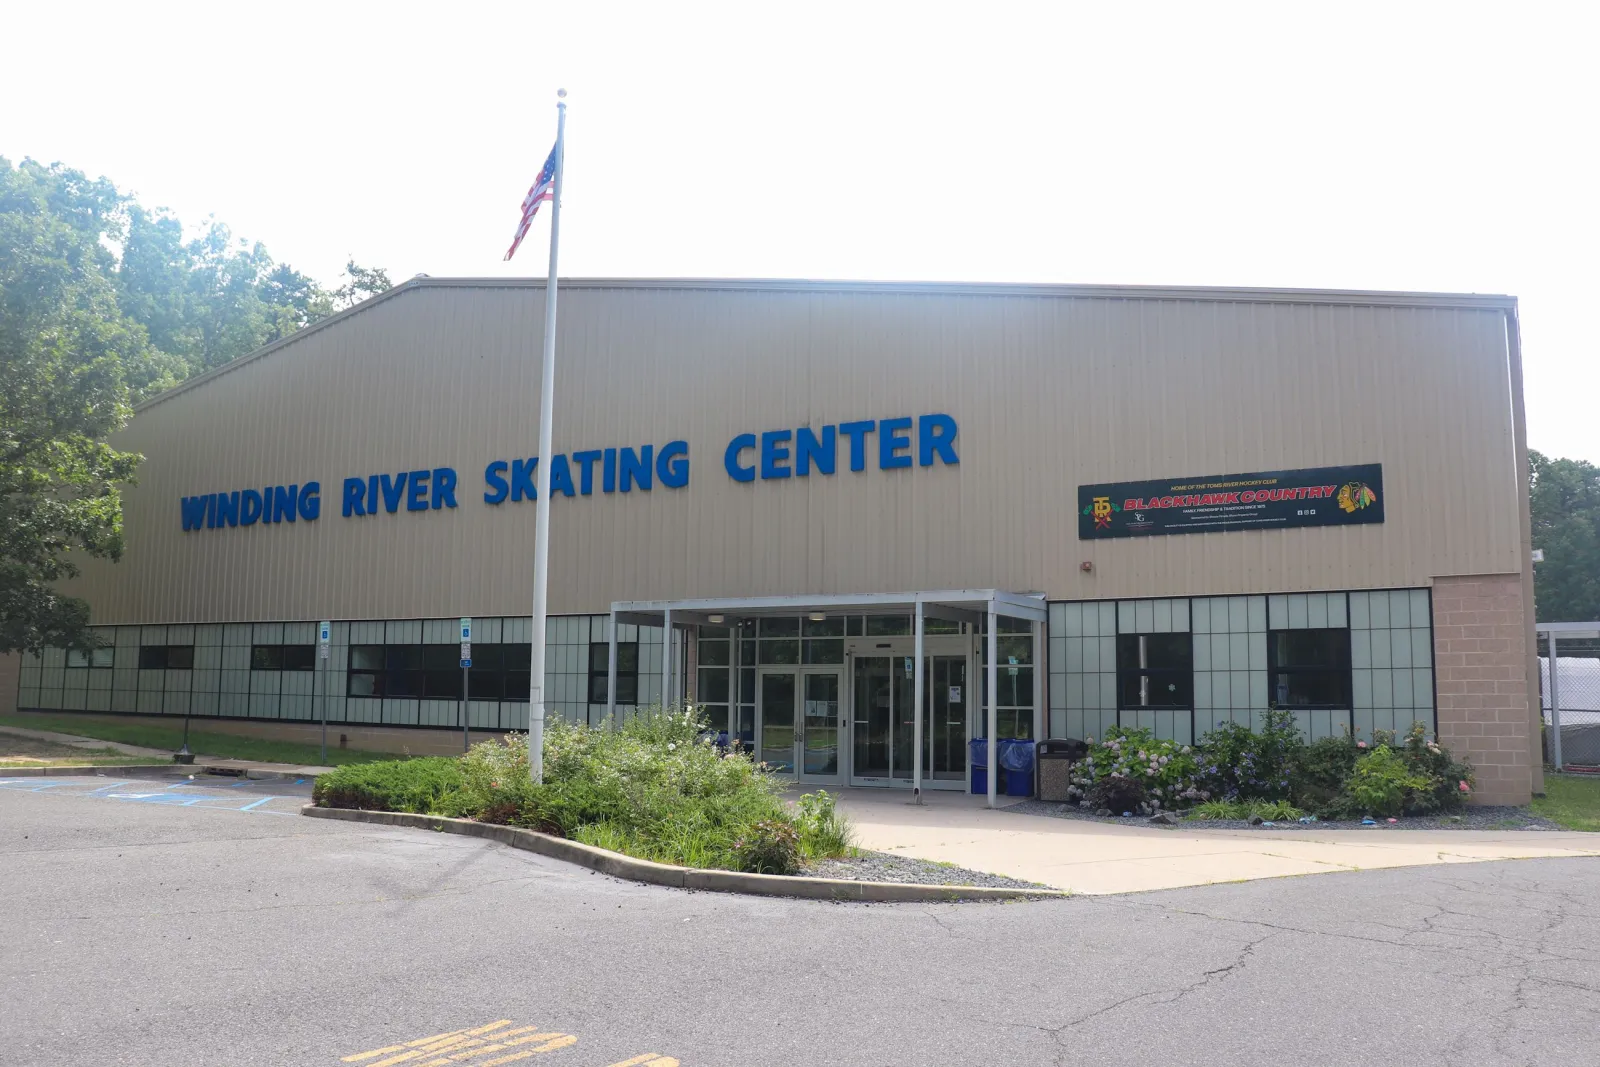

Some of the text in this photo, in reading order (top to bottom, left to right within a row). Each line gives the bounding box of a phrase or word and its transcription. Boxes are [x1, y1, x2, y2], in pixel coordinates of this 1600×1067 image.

[181, 413, 960, 531] WINDING RIVER SKATING CENTER
[1124, 485, 1336, 510] BLACKHAWK COUNTRY
